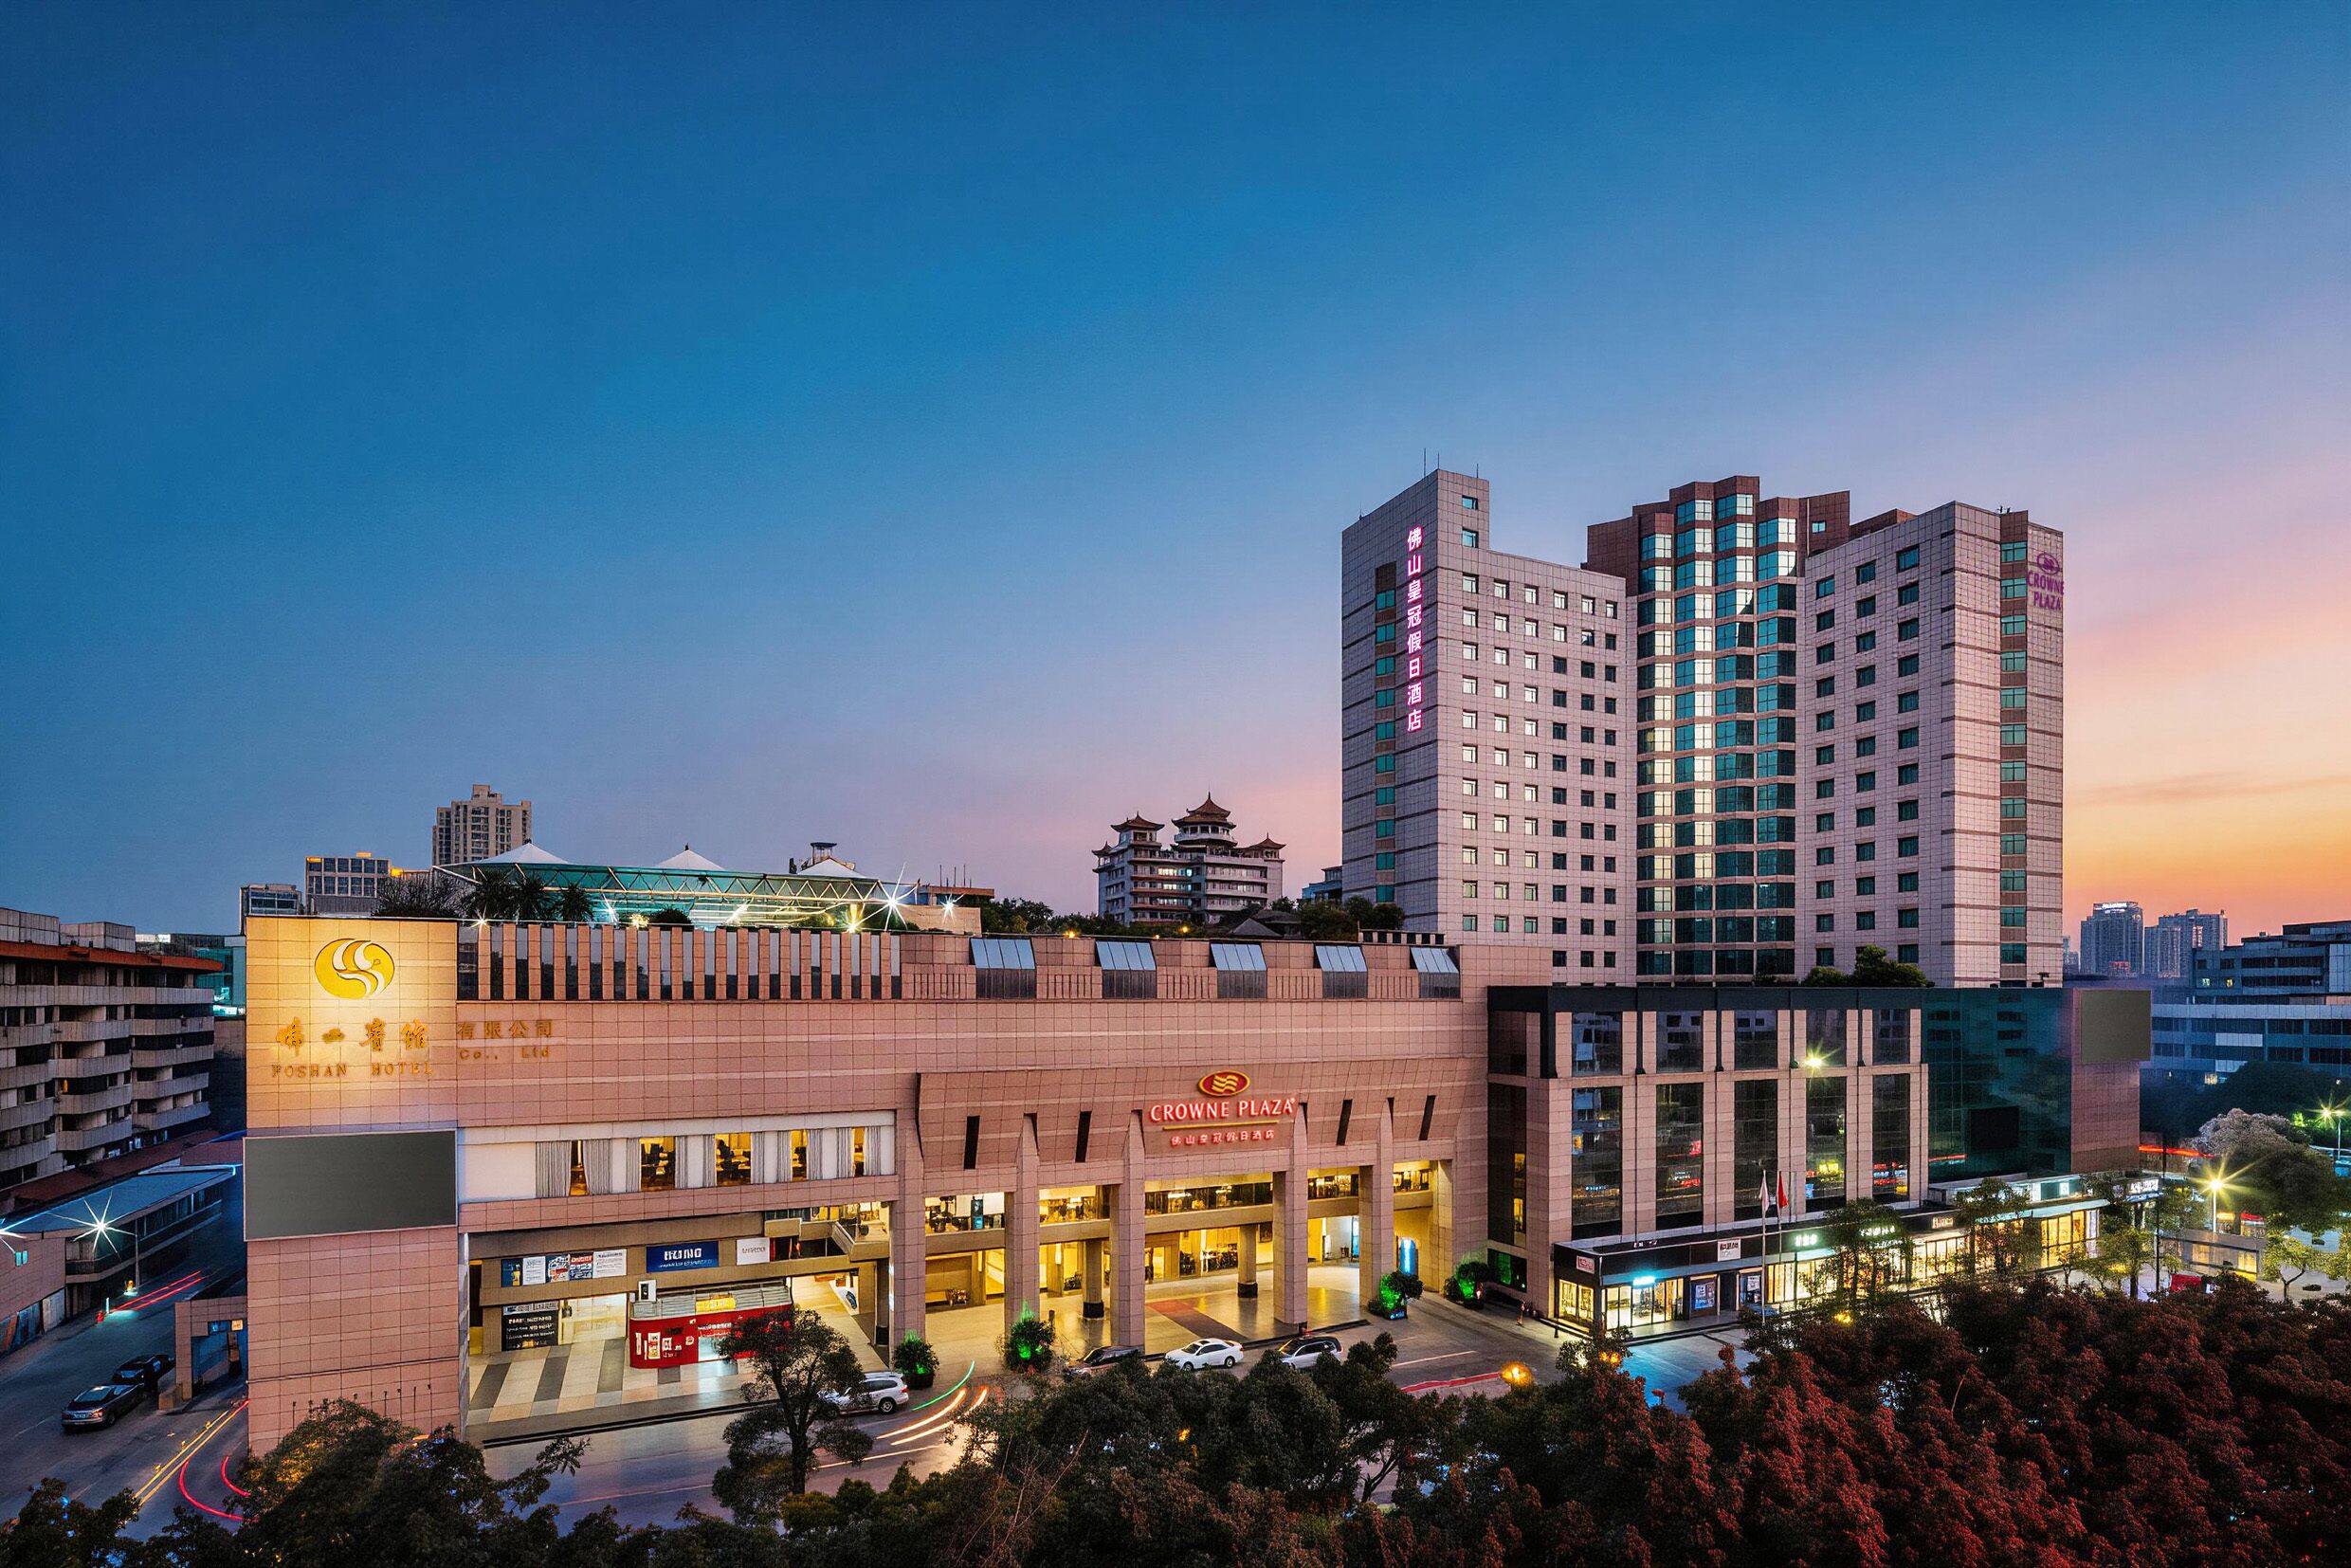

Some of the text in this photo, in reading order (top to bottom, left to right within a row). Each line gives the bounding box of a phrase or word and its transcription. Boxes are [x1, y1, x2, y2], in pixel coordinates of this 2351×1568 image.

[2027, 571, 2065, 595] CROWNE
[2033, 591, 2061, 610] PLAZA
[1407, 526, 1423, 732] 佛山皇冠假日酒店
[457, 1019, 554, 1040] 有限公司
[271, 1063, 348, 1078] FOSHAN
[371, 1061, 434, 1077] HOTEL
[1150, 1101, 1230, 1122] CROWNE
